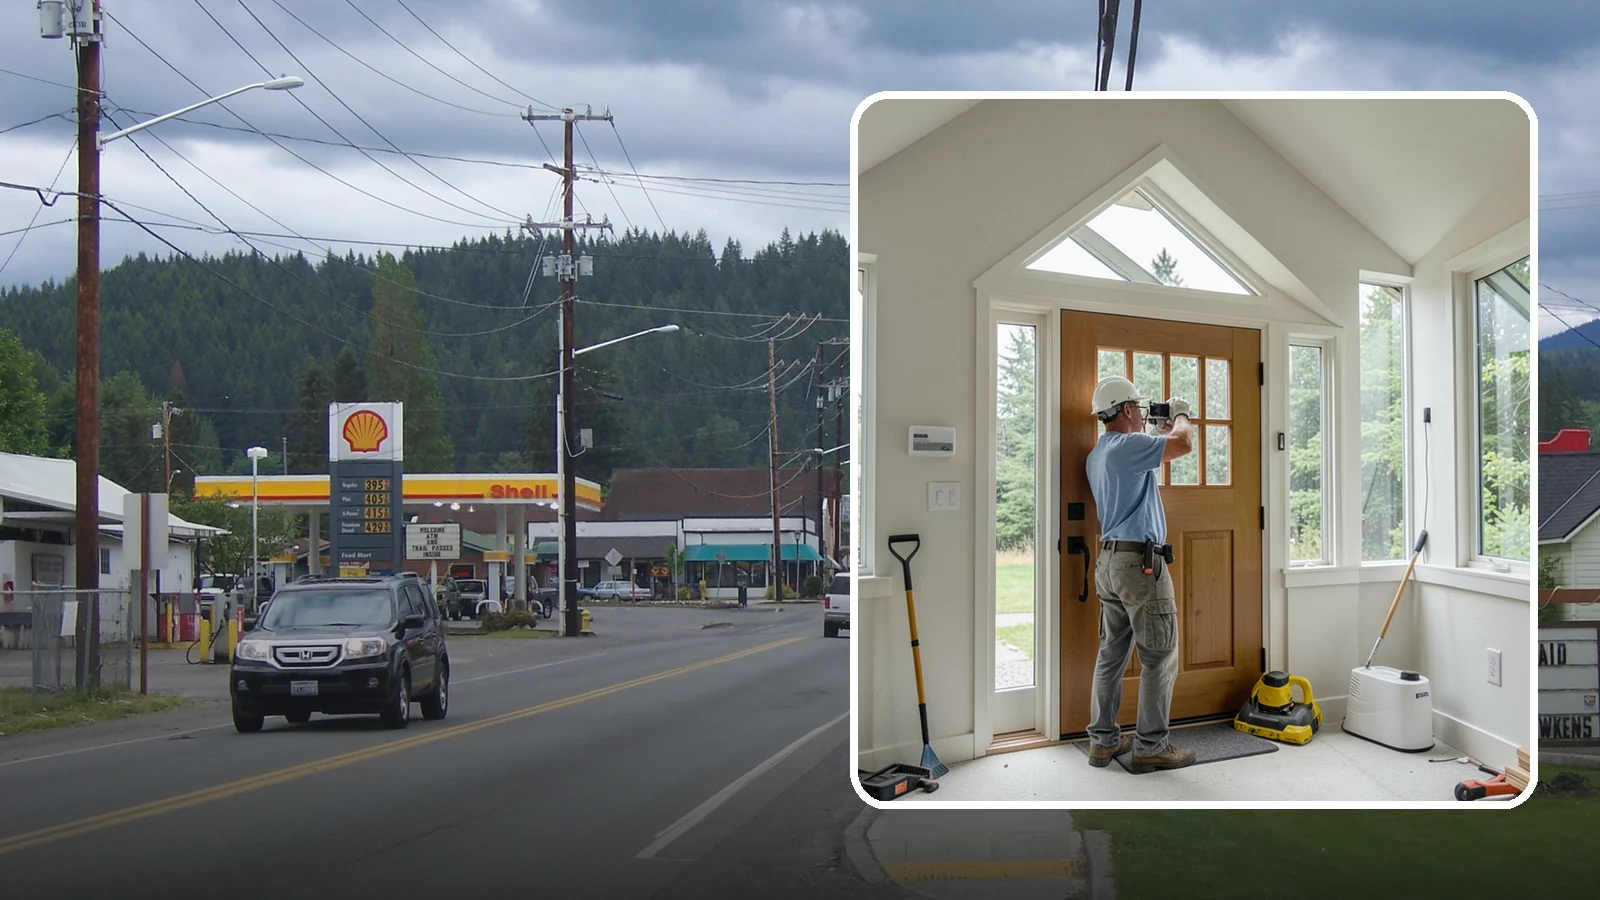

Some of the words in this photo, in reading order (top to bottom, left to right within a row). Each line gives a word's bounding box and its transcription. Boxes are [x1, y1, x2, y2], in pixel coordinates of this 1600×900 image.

[365, 480, 384, 490] 395
[490, 484, 547, 499] Shell
[365, 494, 384, 504] 405
[365, 508, 384, 518] 415
[365, 522, 384, 533] 429
[1538, 642, 1567, 665] AID
